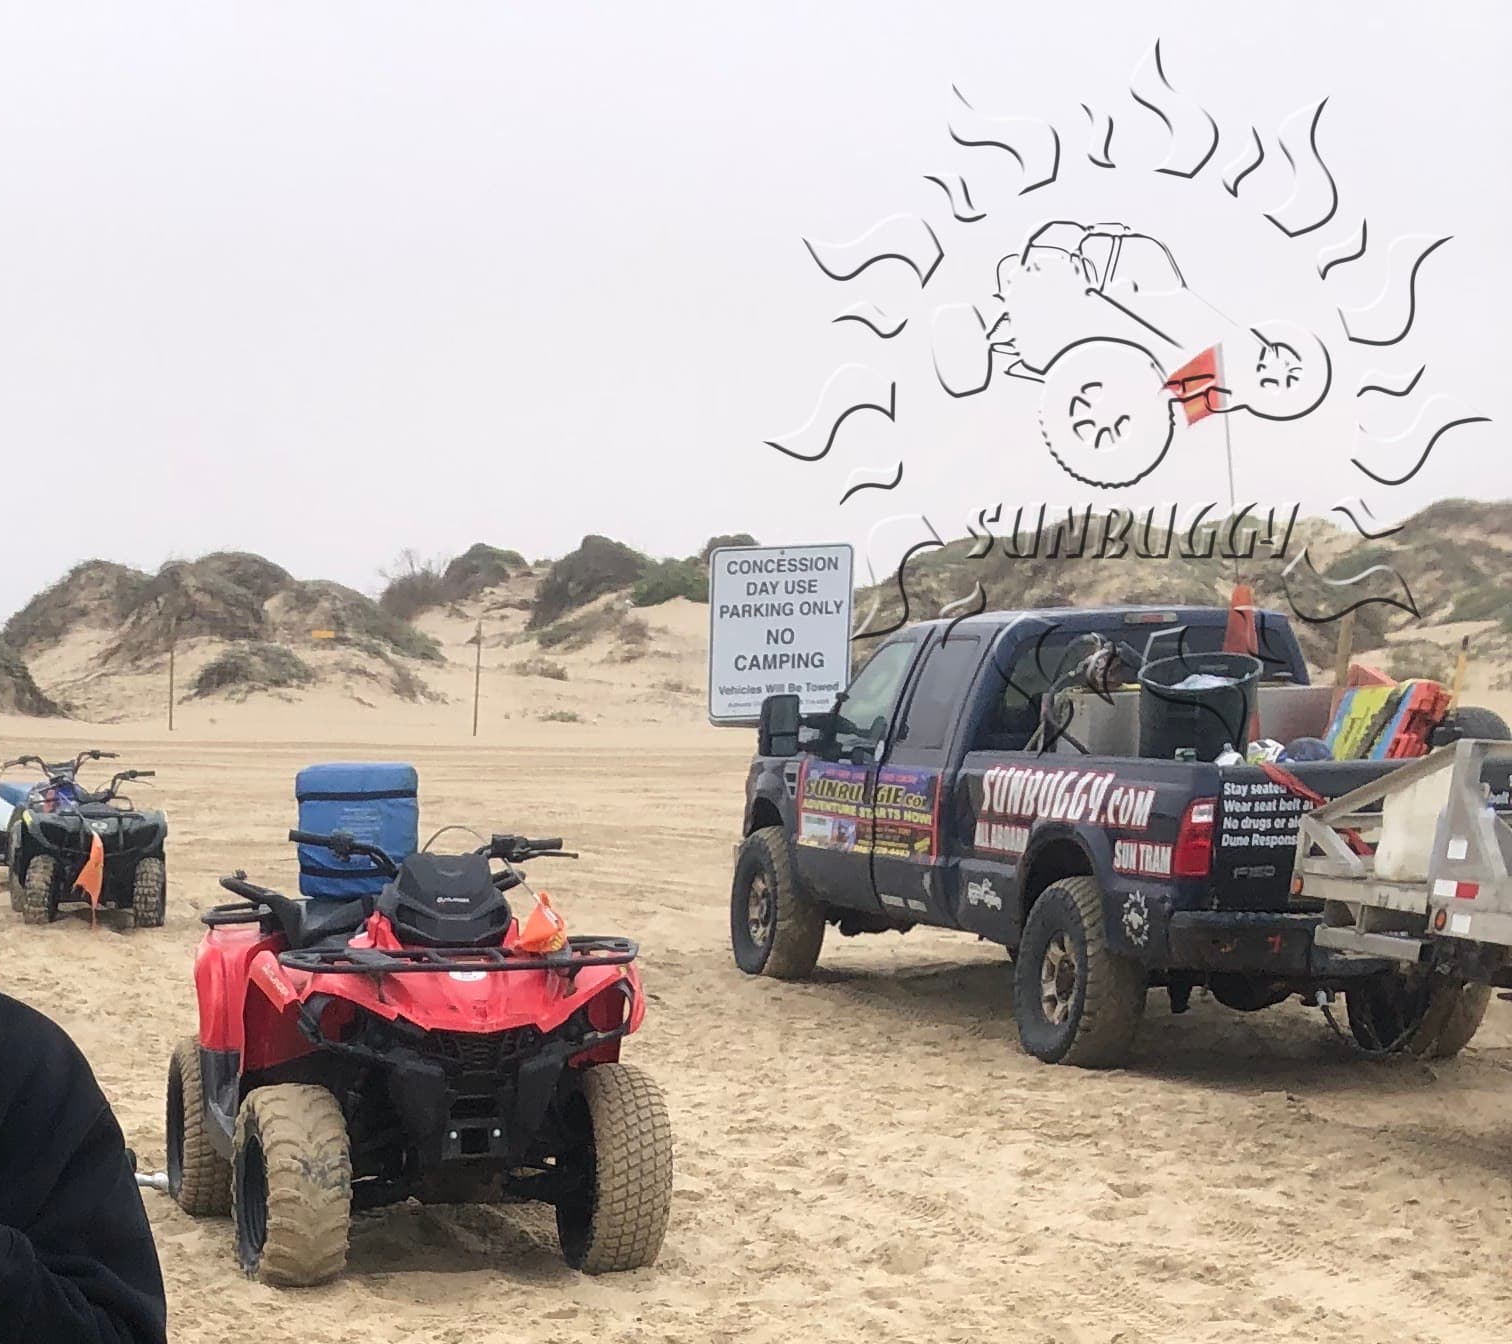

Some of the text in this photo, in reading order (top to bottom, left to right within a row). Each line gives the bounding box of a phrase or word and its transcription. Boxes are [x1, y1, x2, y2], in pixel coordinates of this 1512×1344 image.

[727, 557, 839, 575] CONCESSION
[746, 579, 818, 596] DAY USE
[719, 600, 844, 619] PARKING ONLY
[766, 628, 795, 645] NO
[734, 652, 825, 671] CAMPING
[718, 685, 762, 695] Vehicles
[788, 683, 802, 692] Be
[806, 681, 839, 692] Towed
[1223, 782, 1248, 797] Stay
[1223, 799, 1252, 812] Wear
[1254, 799, 1277, 811] seat
[1279, 797, 1301, 811] belt
[1223, 816, 1239, 829] No
[1241, 816, 1271, 831] drugs
[1274, 817, 1286, 828] or
[1221, 833, 1249, 846] Dune
[1114, 840, 1138, 870] SUN
